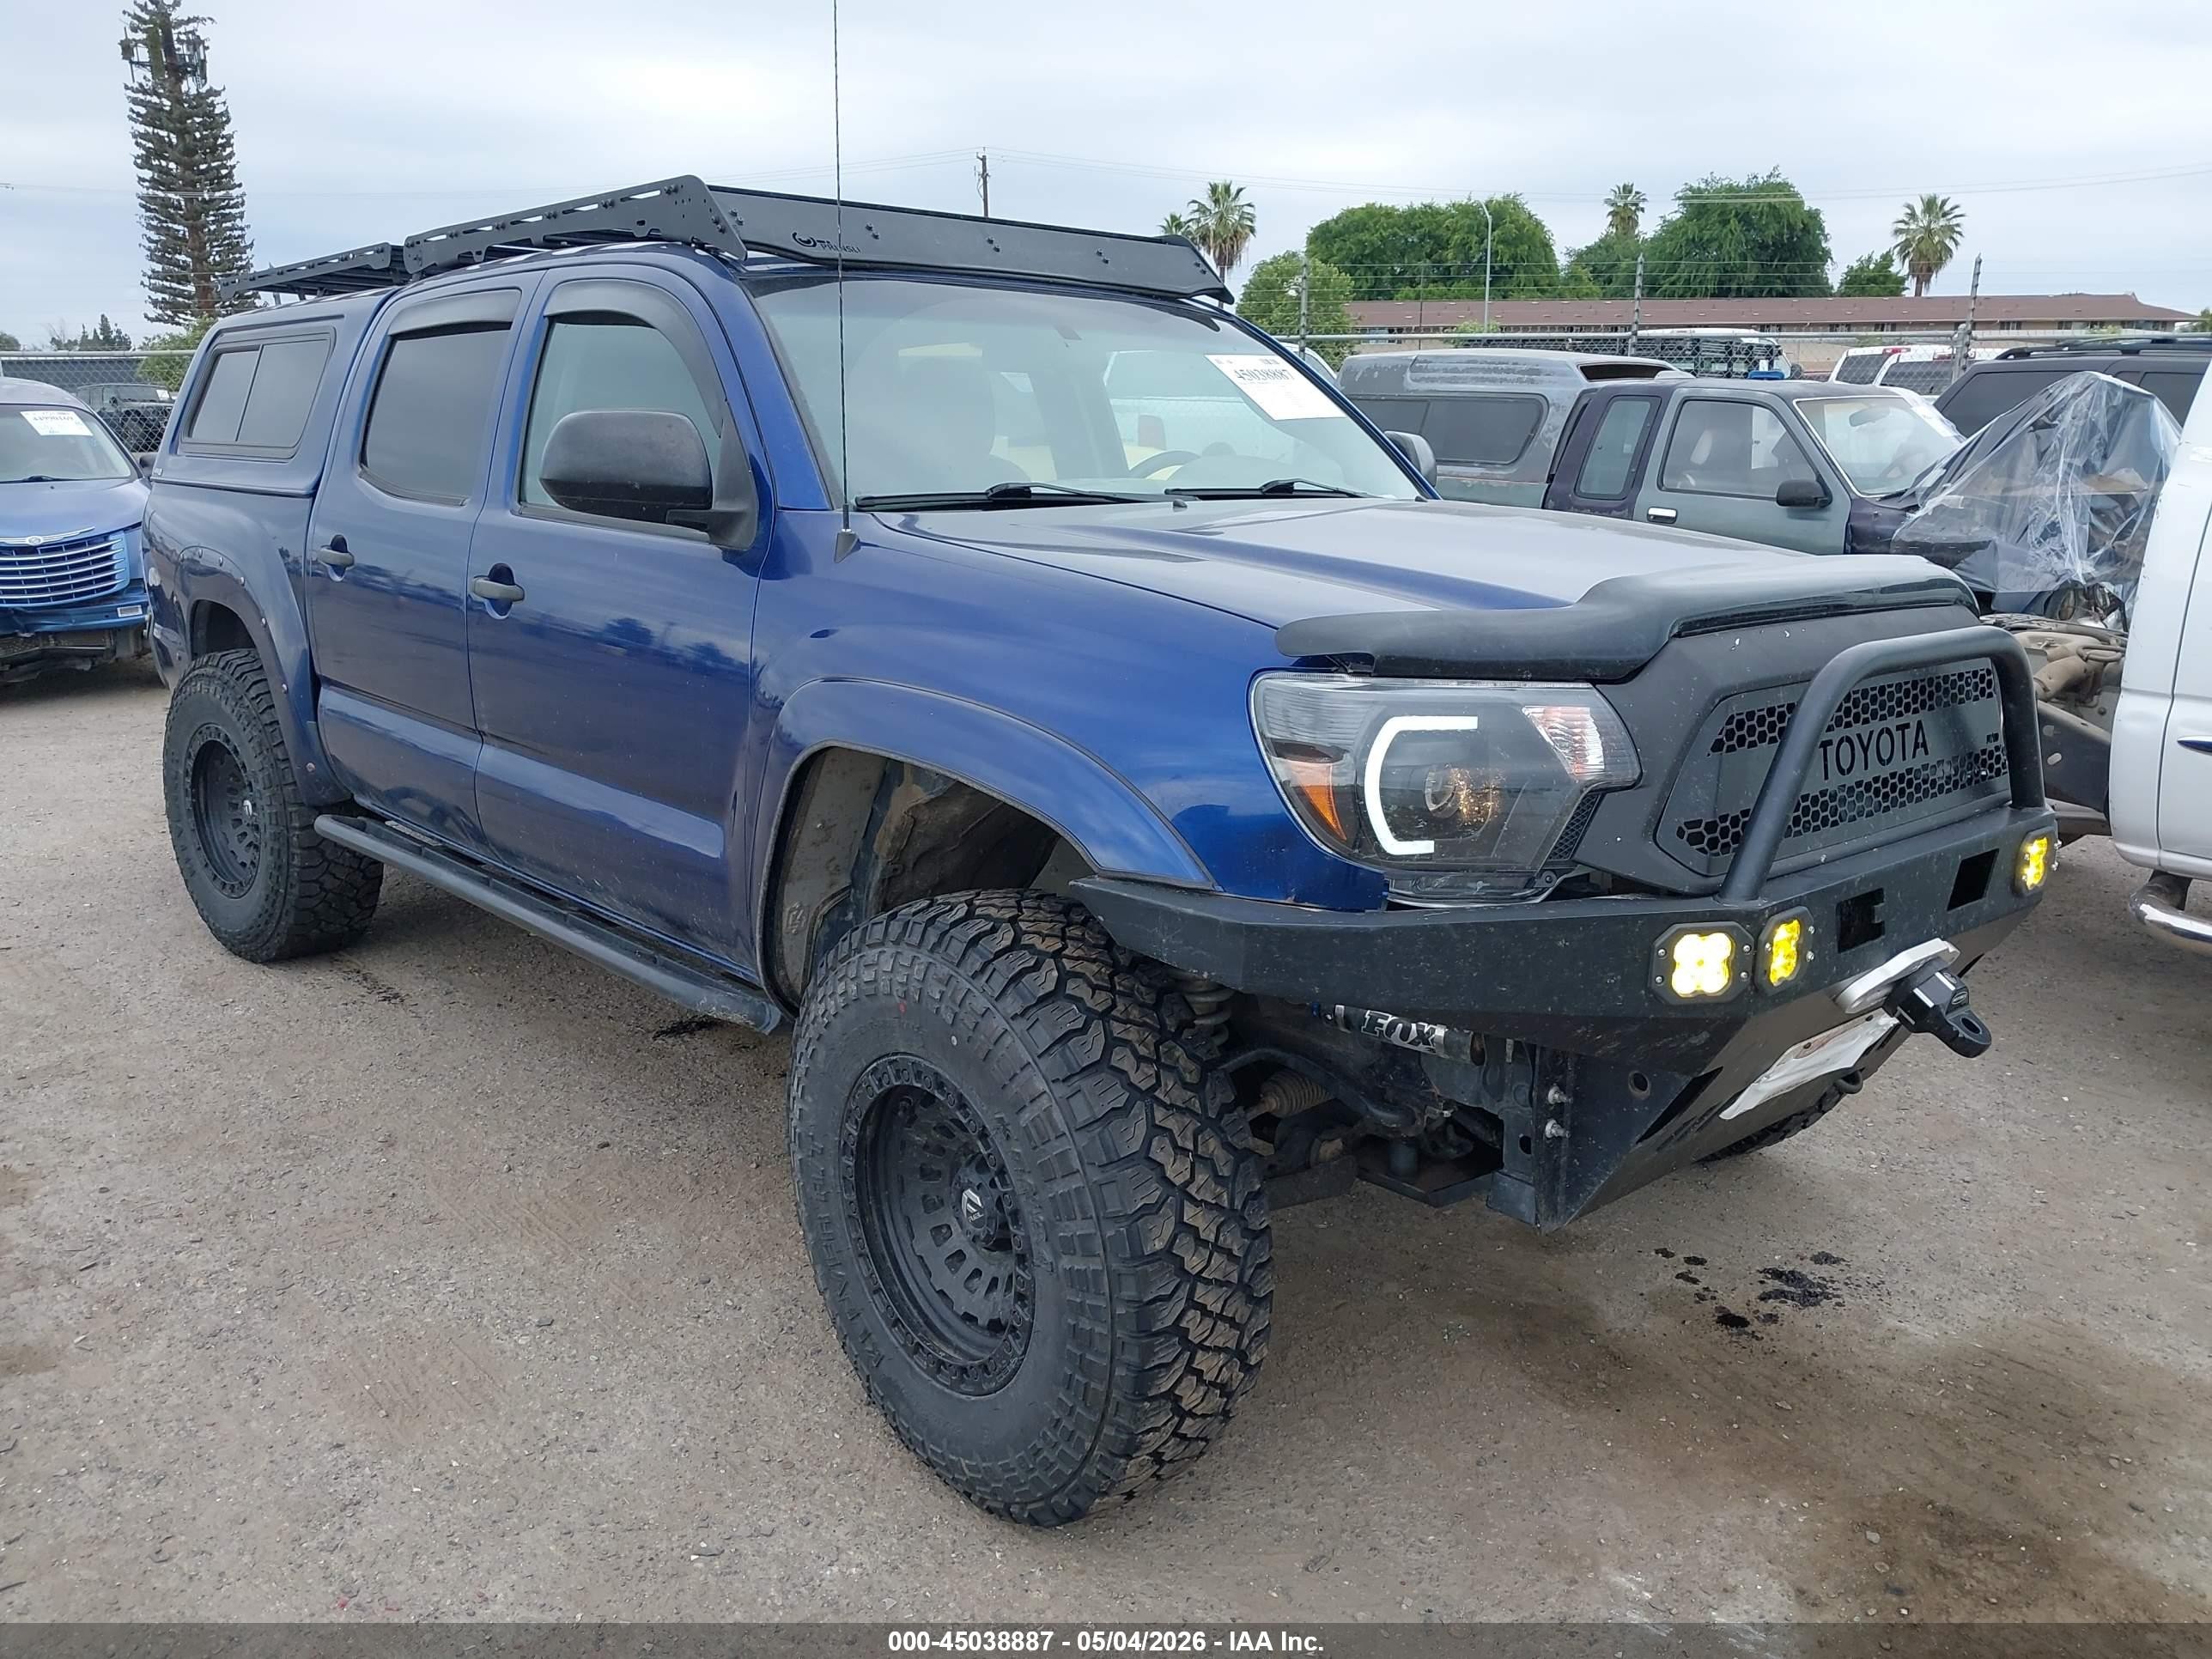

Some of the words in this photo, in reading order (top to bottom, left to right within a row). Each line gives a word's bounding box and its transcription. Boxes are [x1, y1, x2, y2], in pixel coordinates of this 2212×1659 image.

[1233, 368, 1295, 381] 45038887
[1819, 720, 1929, 781] TOYOTA
[1361, 1010, 1437, 1052] FOX
